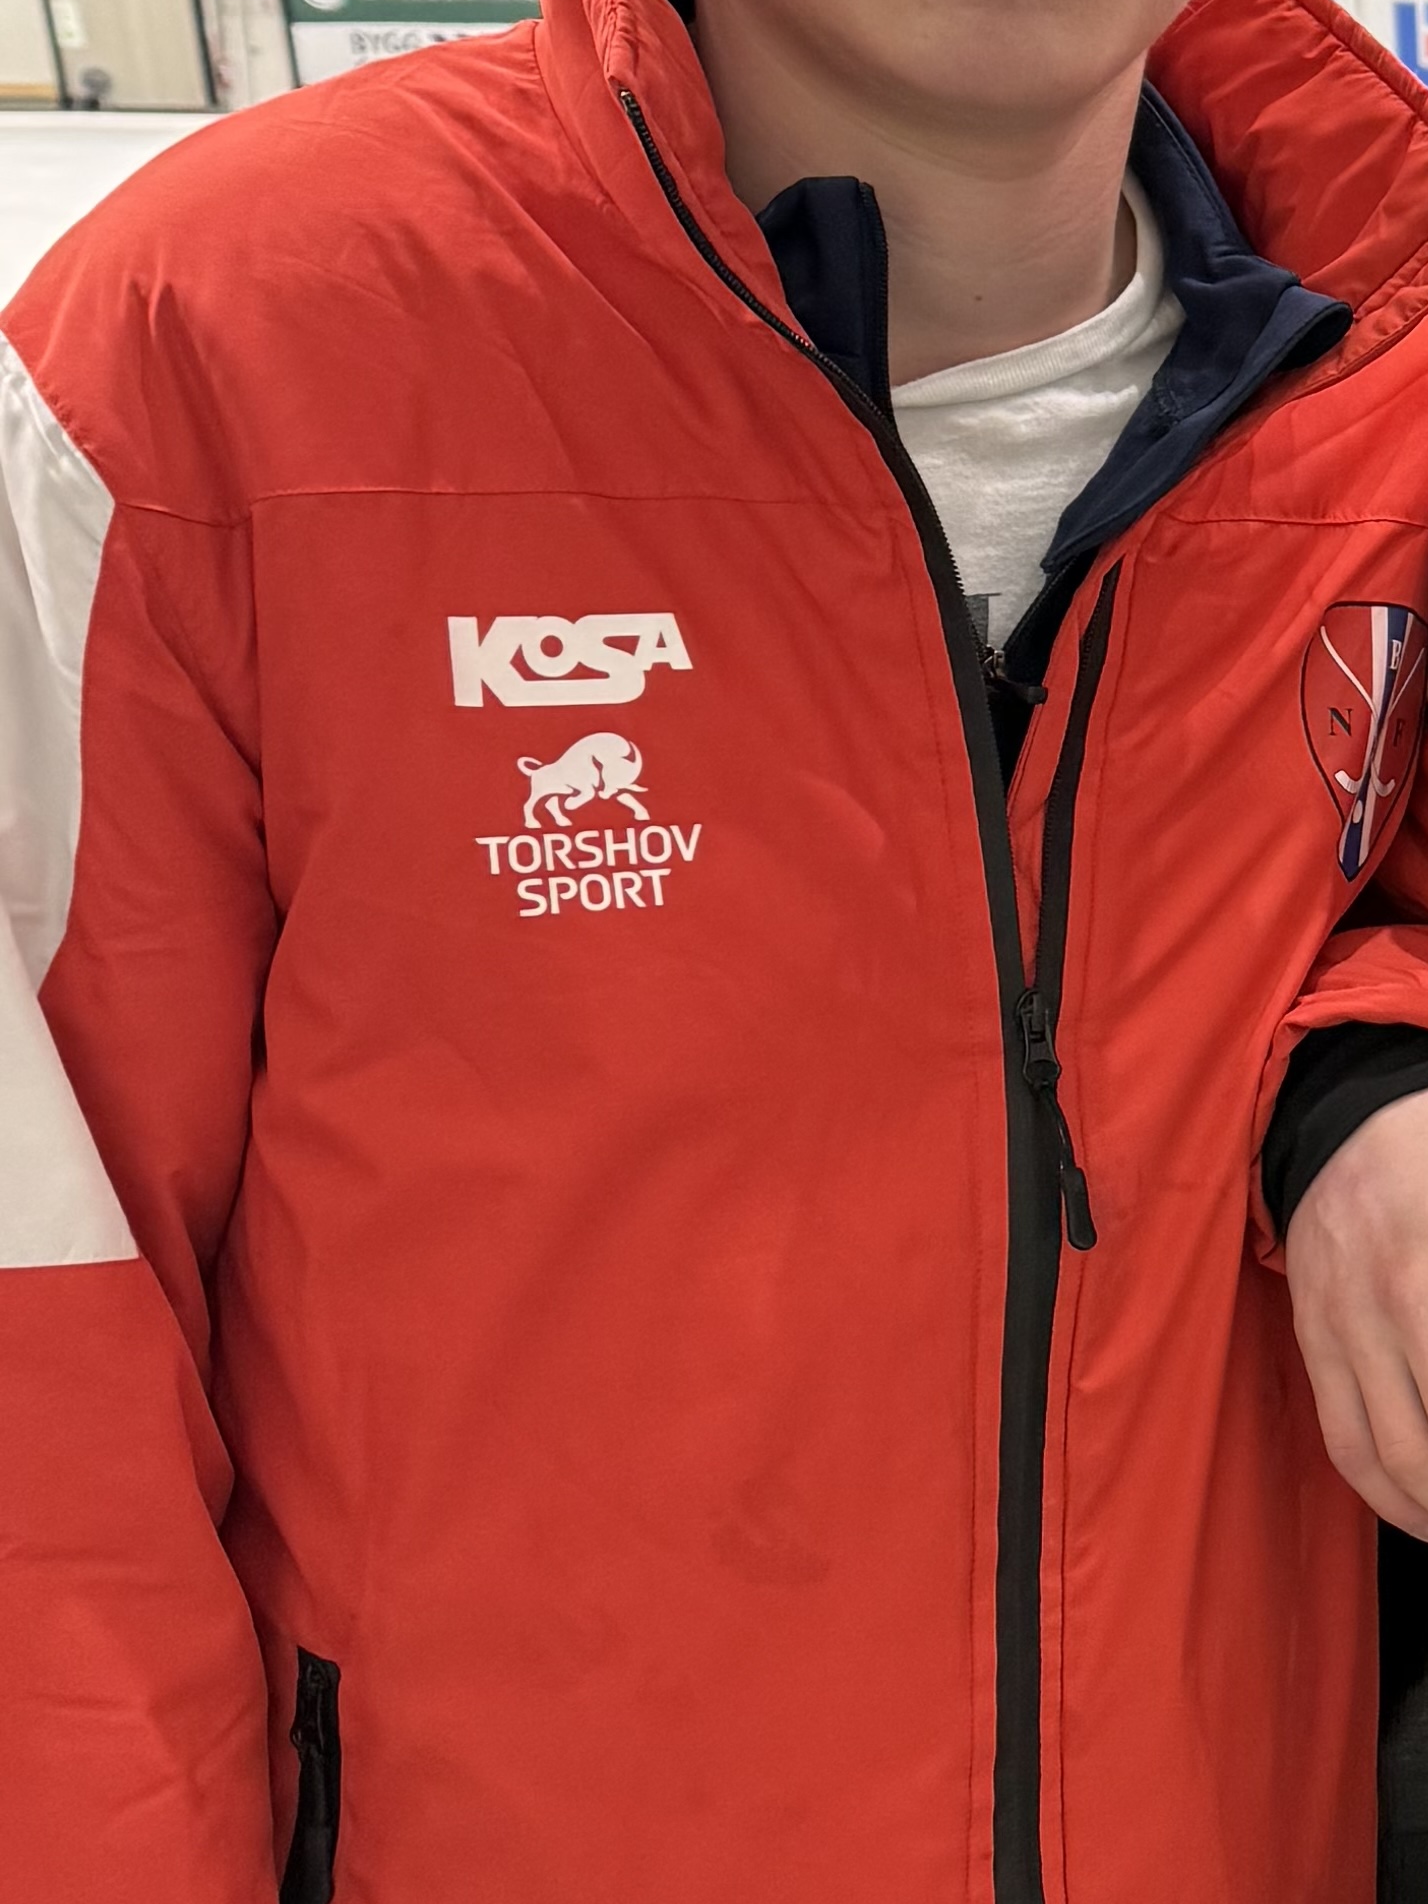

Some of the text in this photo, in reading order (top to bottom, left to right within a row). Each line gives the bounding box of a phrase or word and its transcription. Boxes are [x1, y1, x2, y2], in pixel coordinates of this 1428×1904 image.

[447, 612, 693, 707] KOSA
[1328, 707, 1353, 737] N
[474, 823, 702, 875] TORSHOV
[517, 868, 672, 917] SPORT
